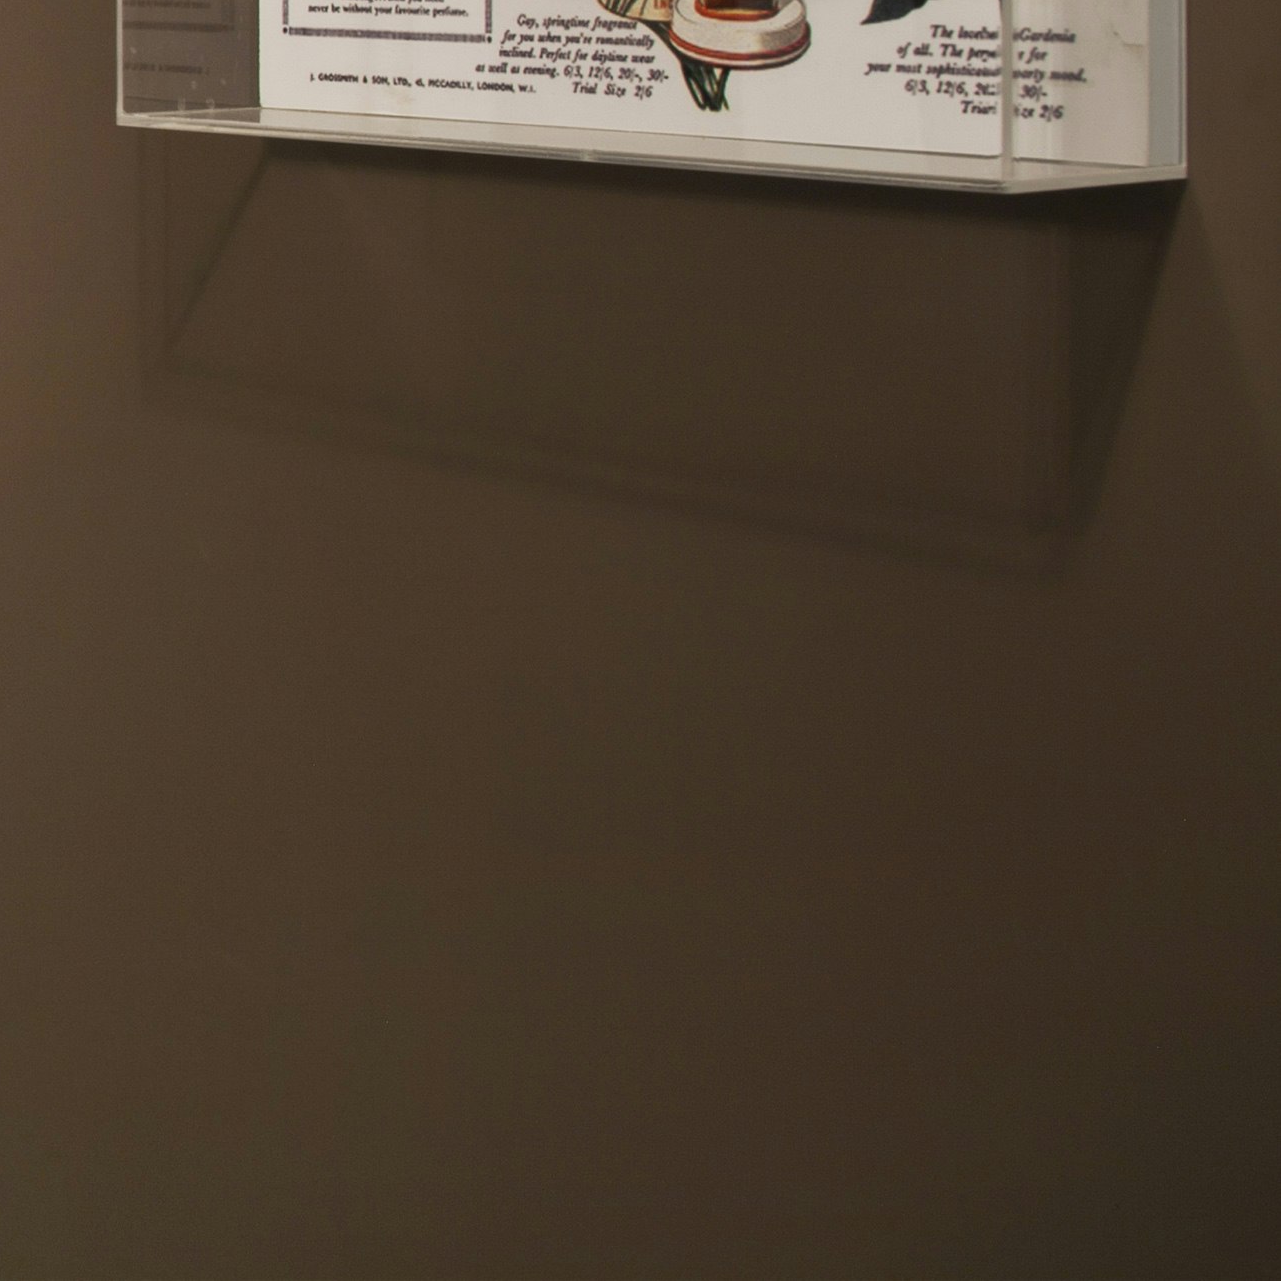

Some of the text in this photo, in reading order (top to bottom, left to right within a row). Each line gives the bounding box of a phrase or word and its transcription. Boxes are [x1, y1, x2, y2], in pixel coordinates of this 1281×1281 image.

[308, 4, 469, 18] never be without your favourite perfume.
[516, 13, 637, 32] Gay, springtime fragrance
[501, 30, 655, 50] for you when you're romantically
[930, 24, 954, 39] The
[1020, 27, 1076, 43] Gardenia
[539, 48, 571, 62] Perfect
[573, 48, 587, 63] for
[631, 55, 655, 63] wear
[896, 42, 911, 59] of
[913, 43, 933, 57] all.
[940, 44, 963, 58] The
[1026, 46, 1048, 64] for
[475, 64, 485, 72] as
[488, 62, 507, 73] well
[523, 64, 559, 78] evening.
[864, 63, 891, 75] your
[896, 64, 921, 74] most
[1050, 69, 1087, 82] mood.
[372, 75, 390, 85] SON,
[476, 81, 515, 93] LONDON,
[572, 82, 653, 100] Trial Size 2/6
[1039, 105, 1064, 122] 2/6
